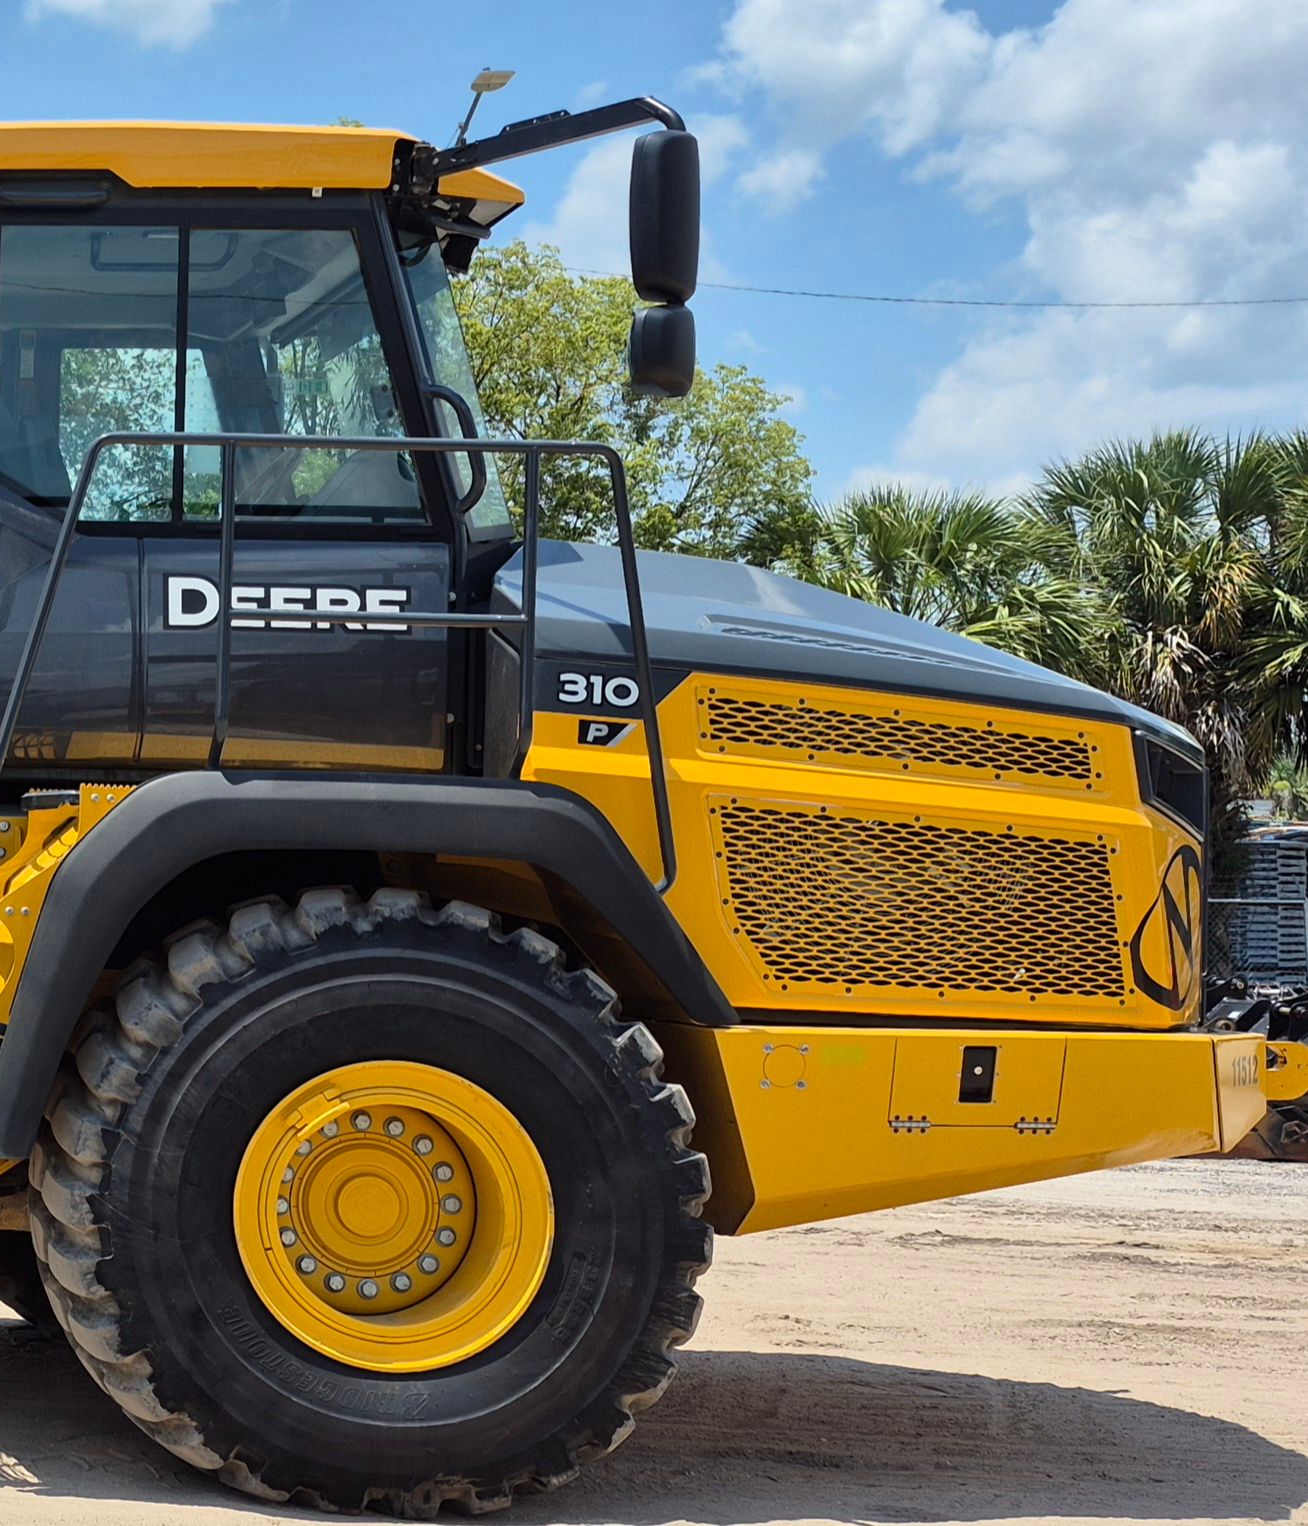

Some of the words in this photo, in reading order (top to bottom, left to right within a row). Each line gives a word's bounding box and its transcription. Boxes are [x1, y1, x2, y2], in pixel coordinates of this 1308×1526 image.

[167, 576, 408, 631] DEERE
[558, 673, 640, 707] 310
[587, 722, 609, 745] P
[1232, 1054, 1258, 1087] 11512
[217, 1305, 432, 1421] BRIDGESTONE
